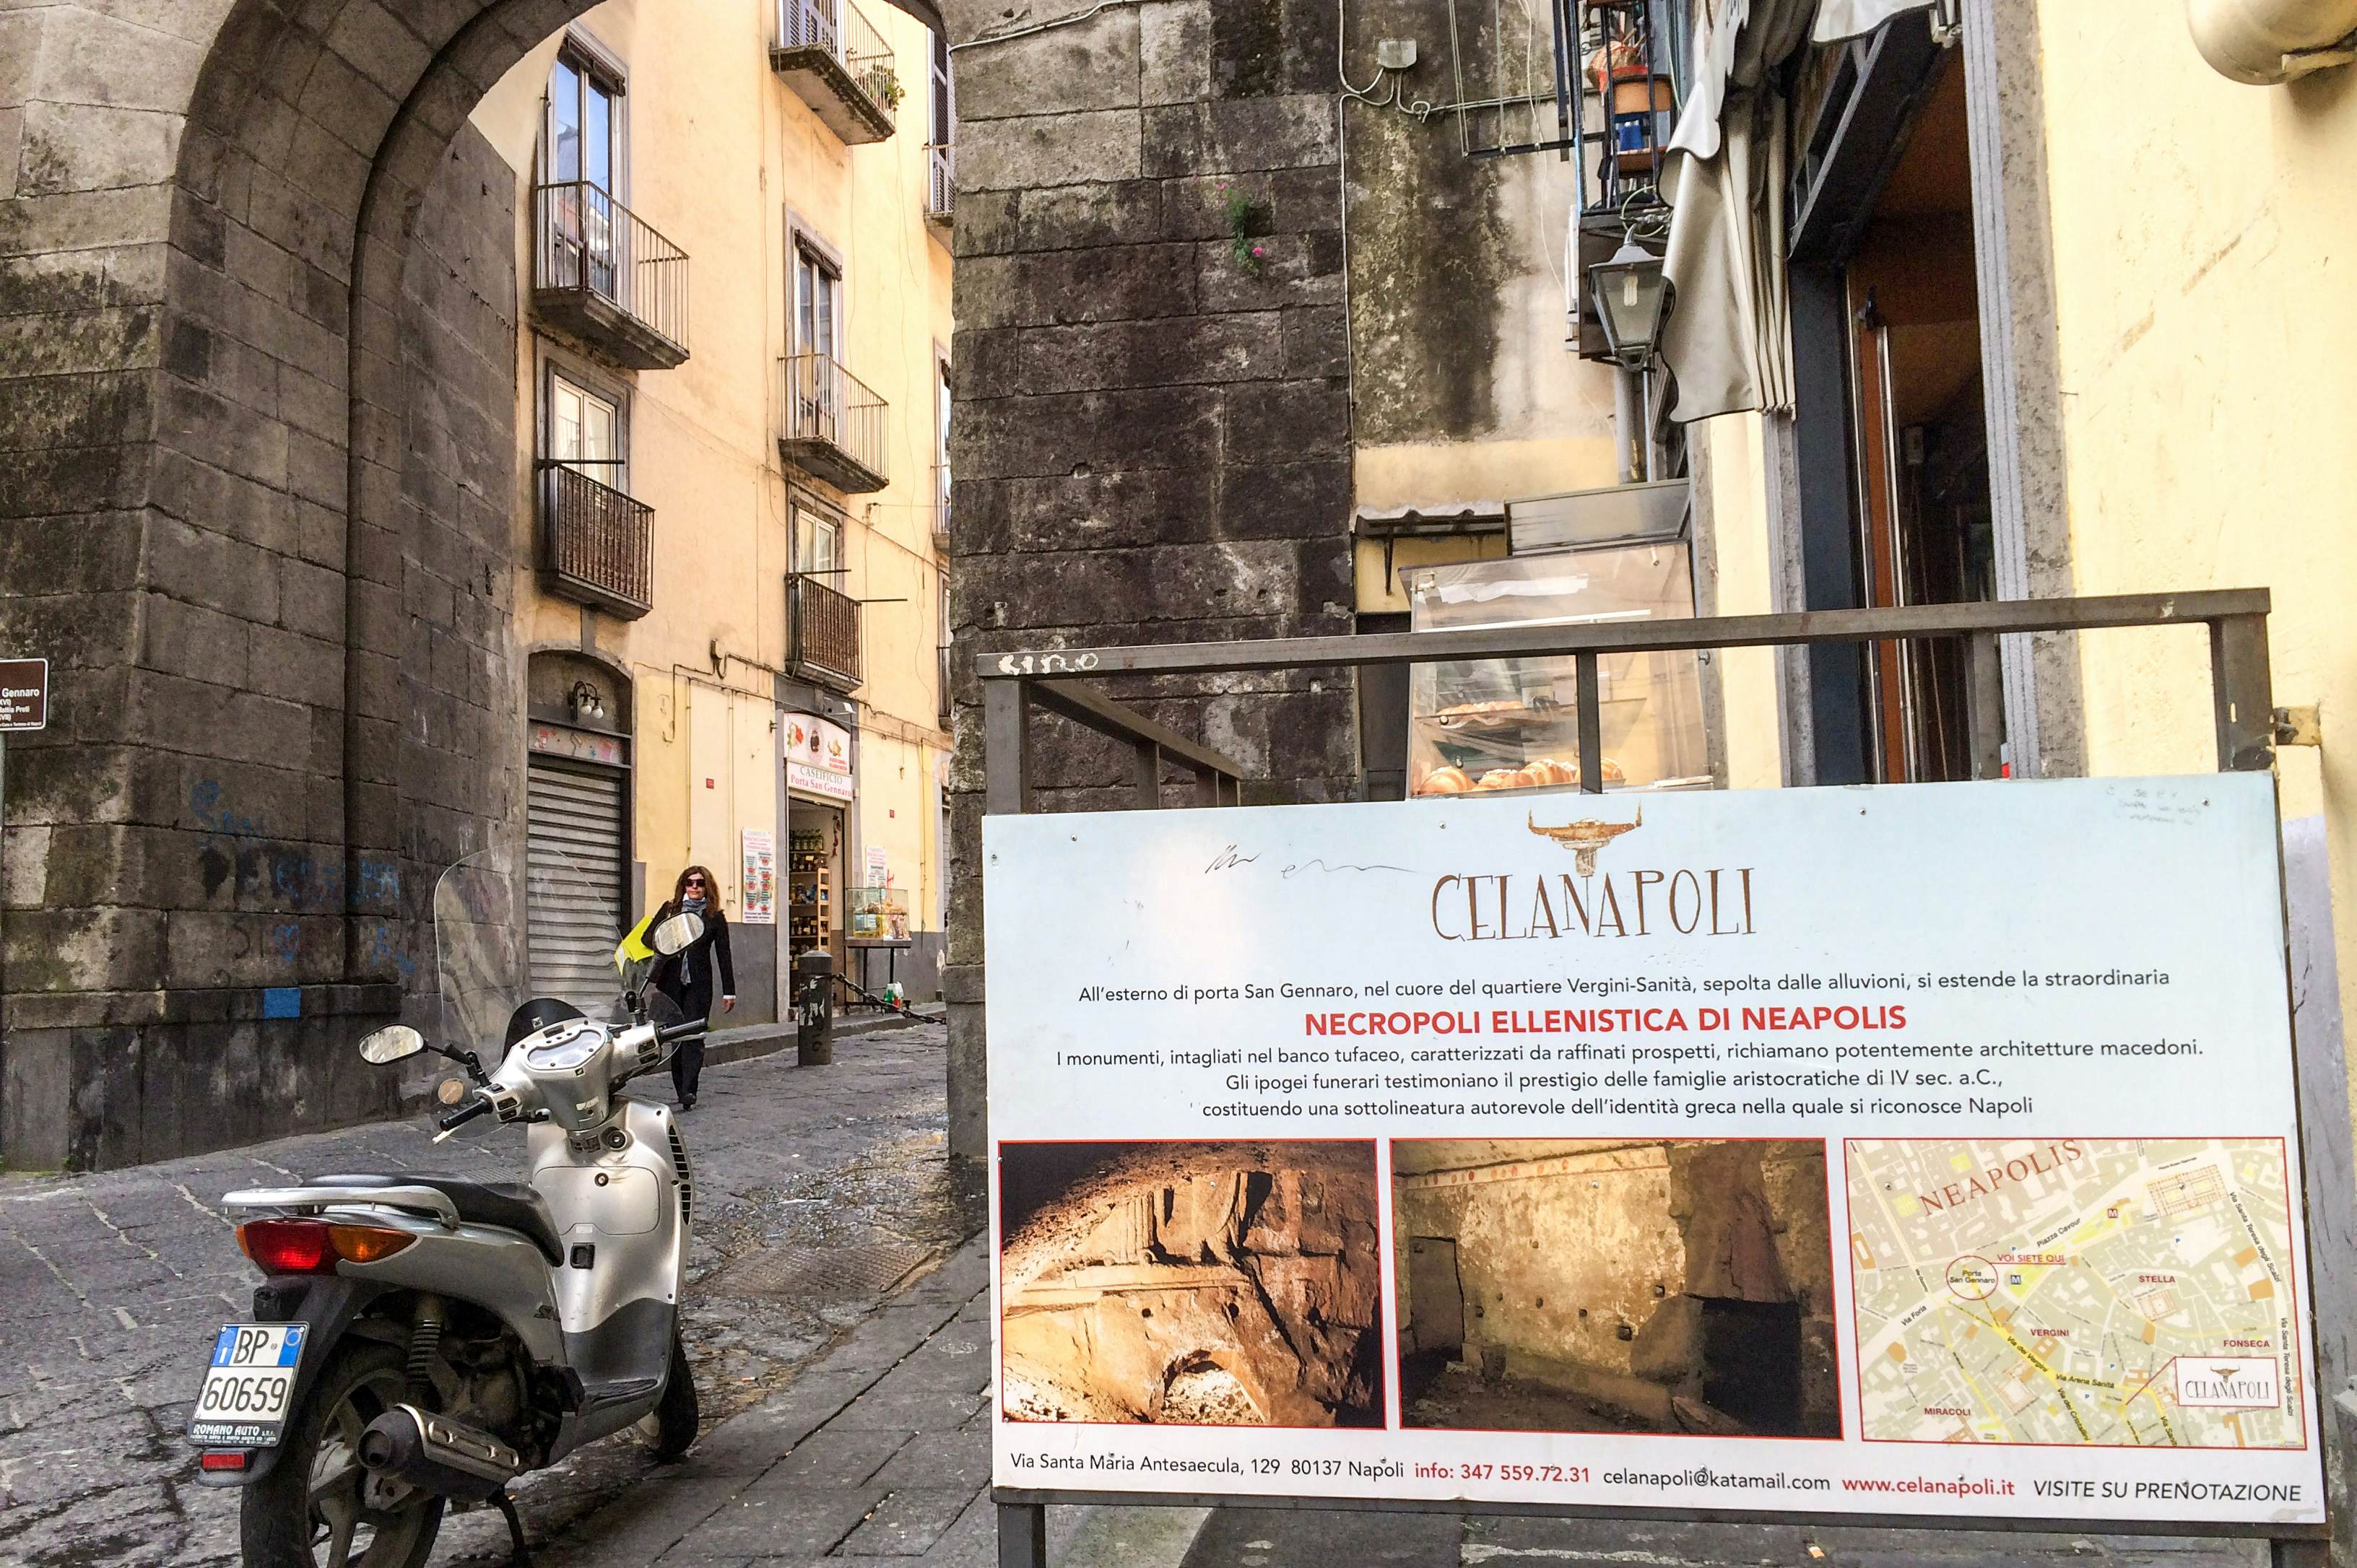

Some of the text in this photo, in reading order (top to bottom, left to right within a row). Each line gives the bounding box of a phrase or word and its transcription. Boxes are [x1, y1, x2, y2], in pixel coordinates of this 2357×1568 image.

[1, 687, 40, 698] Gennaro
[791, 774, 852, 798] Porta San Gennaro
[800, 766, 843, 785] CASEIFICIO
[1432, 868, 1757, 941] CELANAPOLI
[1078, 968, 2169, 1005] All'esterno di porta San Gennaro, nel cuore del quartiere Vergini-Sanità, sepolta dalle alluvioni, si estende la straordinaria
[1305, 1005, 1906, 1036] NECROPOLI ELLENISTICA DI NEAPOLIS
[1067, 1050, 1164, 1067] monumenti,
[1170, 1047, 1241, 1068] intagliati
[1248, 1047, 1272, 1063] nel
[1278, 1047, 1329, 1063] banco
[1334, 1045, 1405, 1064] tufaceo,
[1410, 1045, 1524, 1062] caratterizzati
[1529, 1044, 1551, 1060] da
[1558, 1043, 1625, 1060] raffinati
[1632, 1043, 1720, 1065] prospetti,
[1727, 1042, 1828, 1058] richiamano
[1836, 1042, 1974, 1063] potentemente
[1979, 1040, 2093, 1057] architetture
[2101, 1038, 2203, 1055] macedoni.
[1225, 1068, 2002, 1095] Gli ipogei funerari testimoniano il prestigio delle famiglie aristocratiche di IV sec. a.C.,
[1202, 1096, 2033, 1119] costituendo una sottolineatura autorevole dell'identità greca nella quale si riconosce Napoli
[1918, 1138, 2081, 1216] NEAPOLIS
[2036, 1218, 2080, 1247] Piazza Cavour
[2229, 1191, 2282, 1283] Via Santa Teresa degli Scalzi
[1997, 1254, 2065, 1263] VOI SIETE QUI
[1901, 1305, 1927, 1326] Via Foria
[233, 1330, 269, 1364] BP
[2007, 1336, 2049, 1372] Via dei Vergini
[2283, 1352, 2291, 1375] Teresa
[203, 1376, 287, 1413] 60659
[2070, 1375, 2090, 1385] Arena
[2093, 1379, 2115, 1389] Sanità
[2185, 1380, 2270, 1400] CELANAPOLI
[1924, 1408, 1971, 1416] MIRACOLI
[2057, 1388, 2066, 1399] Via
[2064, 1398, 2072, 1411] dei
[193, 1424, 233, 1435] ROMANO
[234, 1425, 260, 1436] AUTO
[1010, 1452, 2301, 1502] Via Santa Maria Antesaecula, 129 80137 Napoli info: 347 559.72.31 celanapoli@katamail.com www.celanapoli.it VISITE SU PRENOTAZIONE
